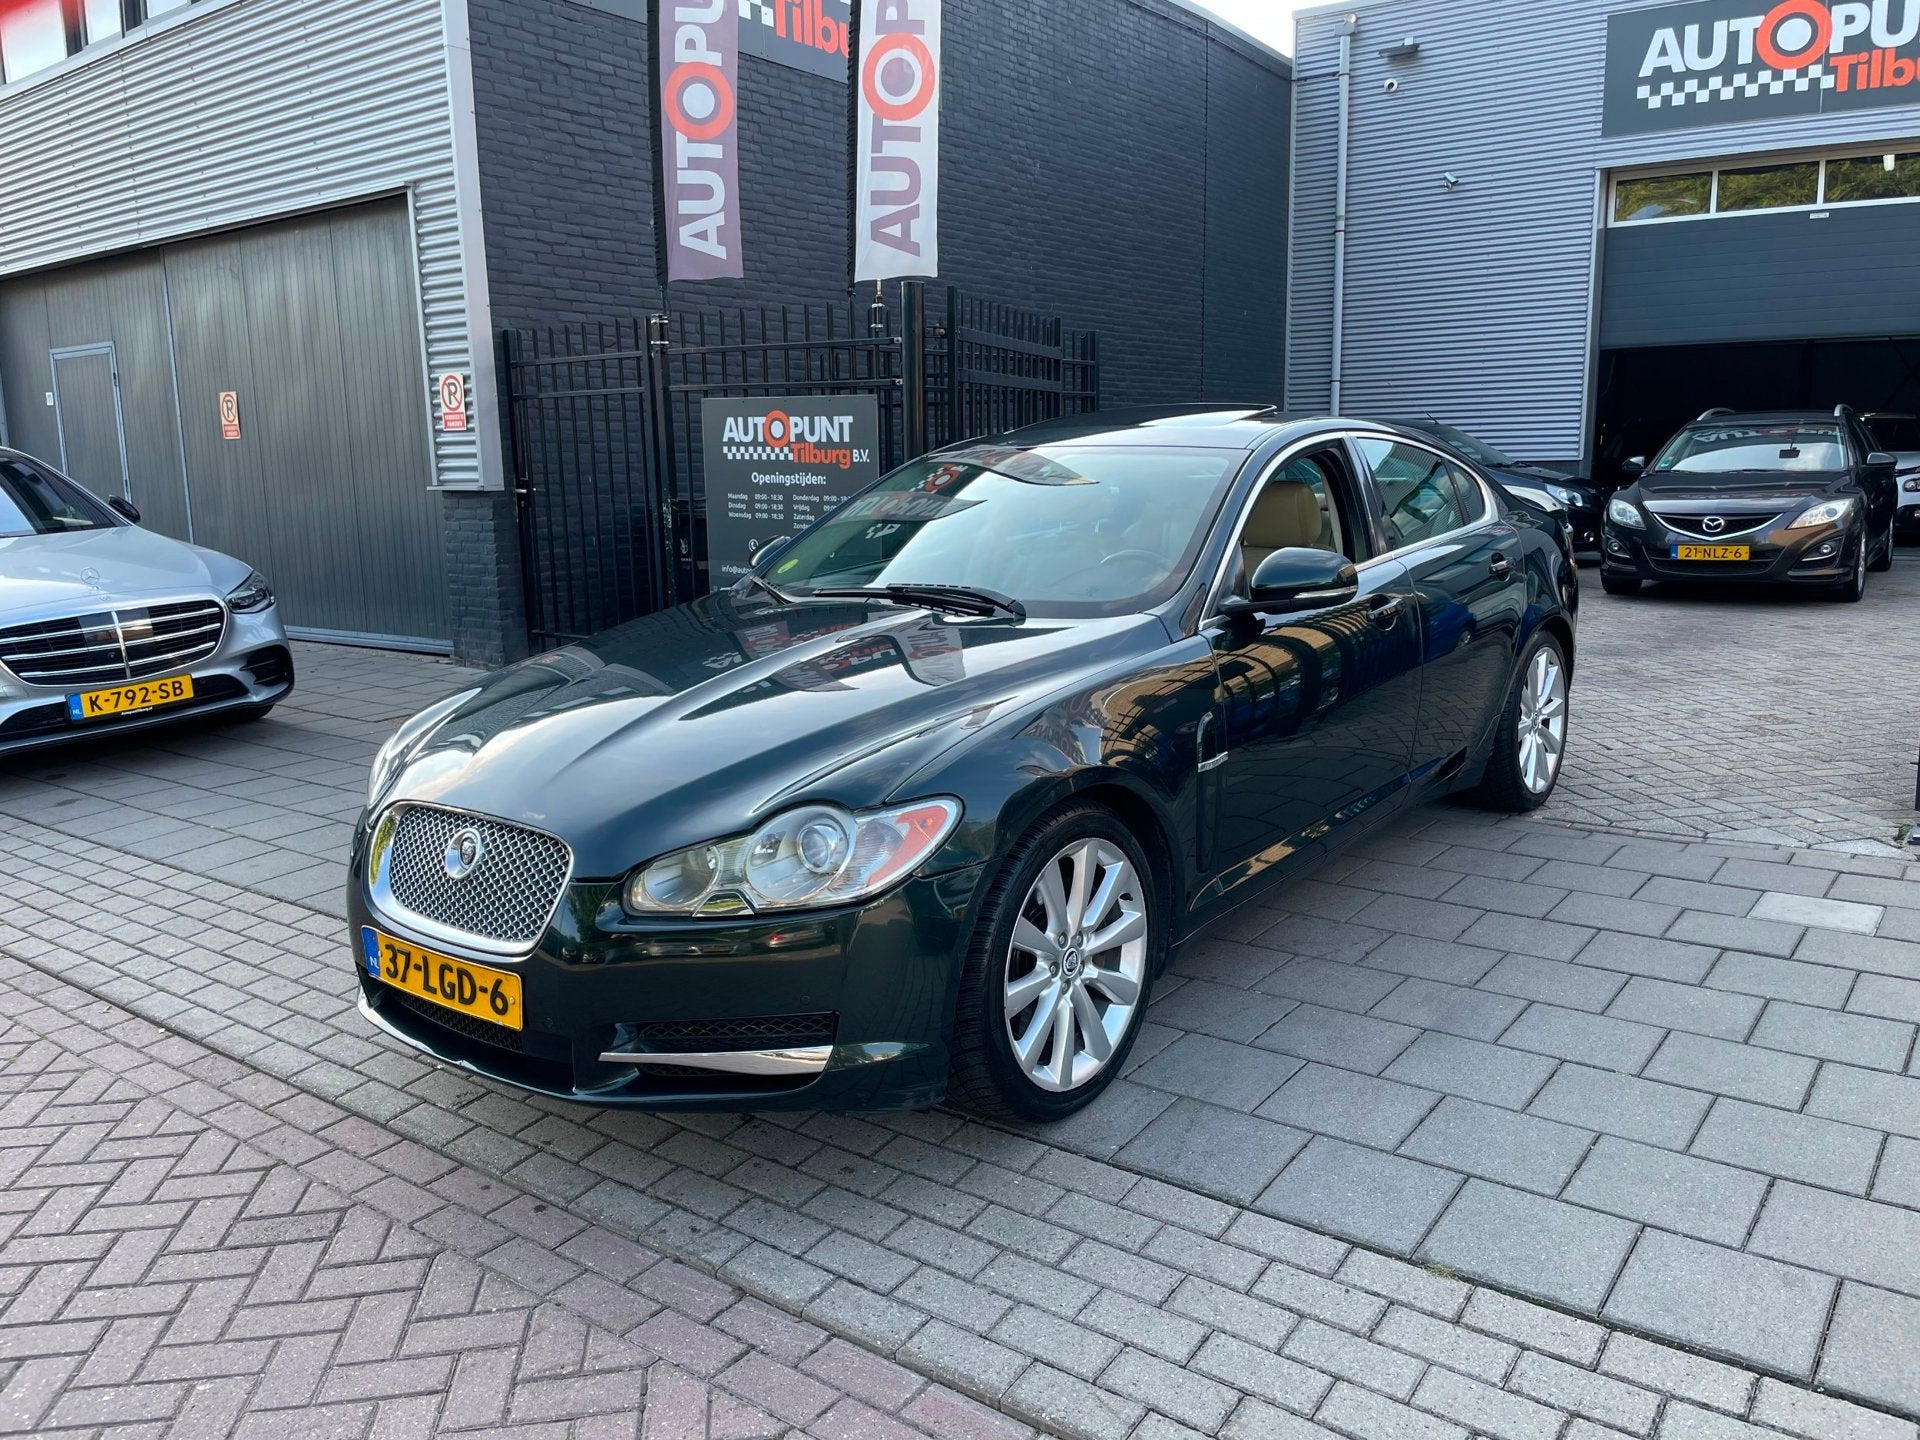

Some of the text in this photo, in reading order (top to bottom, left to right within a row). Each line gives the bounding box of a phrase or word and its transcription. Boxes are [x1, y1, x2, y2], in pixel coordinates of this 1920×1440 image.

[1638, 0, 1920, 78] AUTOPU
[1829, 48, 1920, 92] Tilb
[723, 410, 853, 448] AUTOPUNT
[791, 443, 870, 469] Tilburg B.V.
[751, 472, 826, 486] Openingstijden:
[727, 493, 749, 501] Maandag
[792, 494, 820, 502] Donderdag
[728, 502, 746, 510] Dinsdag
[793, 504, 810, 512] Vrijdag
[728, 511, 752, 519] Woensdag
[1684, 547, 1742, 558] 21-NLZ-6
[89, 680, 184, 713] K-792-SB
[369, 943, 509, 1016] NL 37-LGD-6
